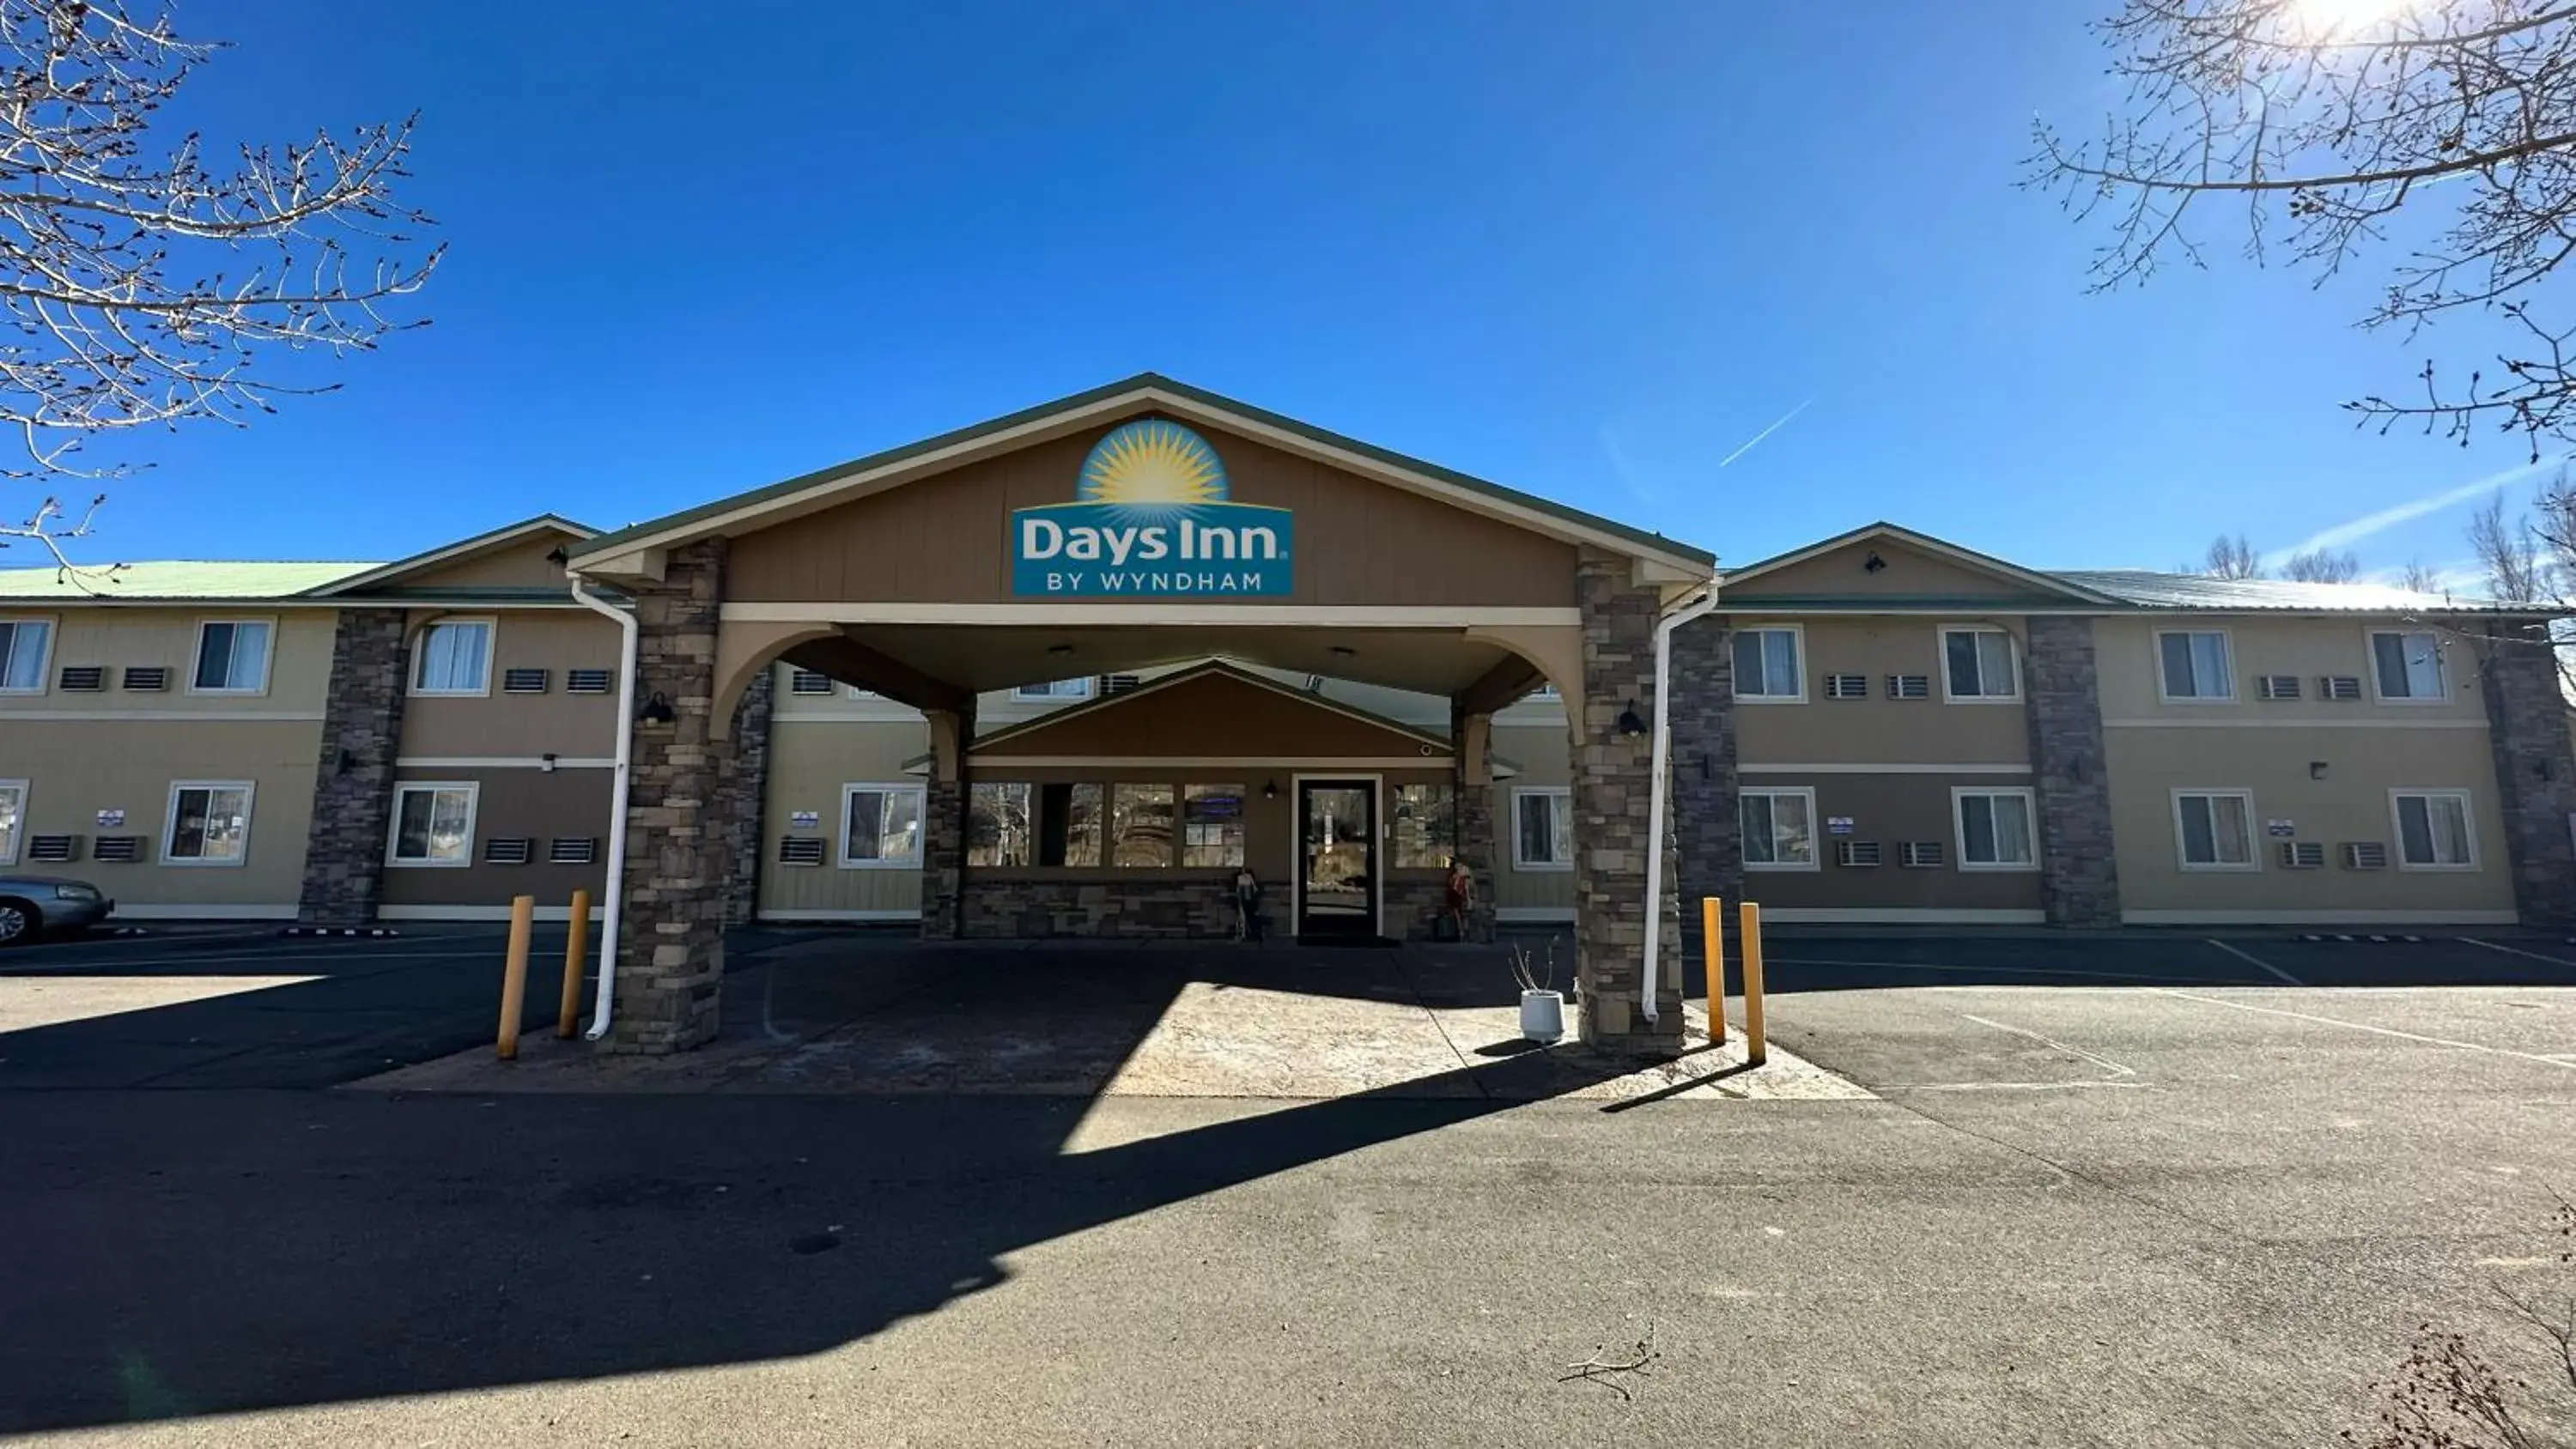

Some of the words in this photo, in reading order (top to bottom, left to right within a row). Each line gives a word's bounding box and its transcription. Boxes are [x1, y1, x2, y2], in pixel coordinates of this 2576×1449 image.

[1022, 518, 1169, 566] Days
[1180, 518, 1277, 560] Inn
[1047, 573, 1084, 591] BY
[1100, 573, 1261, 591] WYNDHAM
